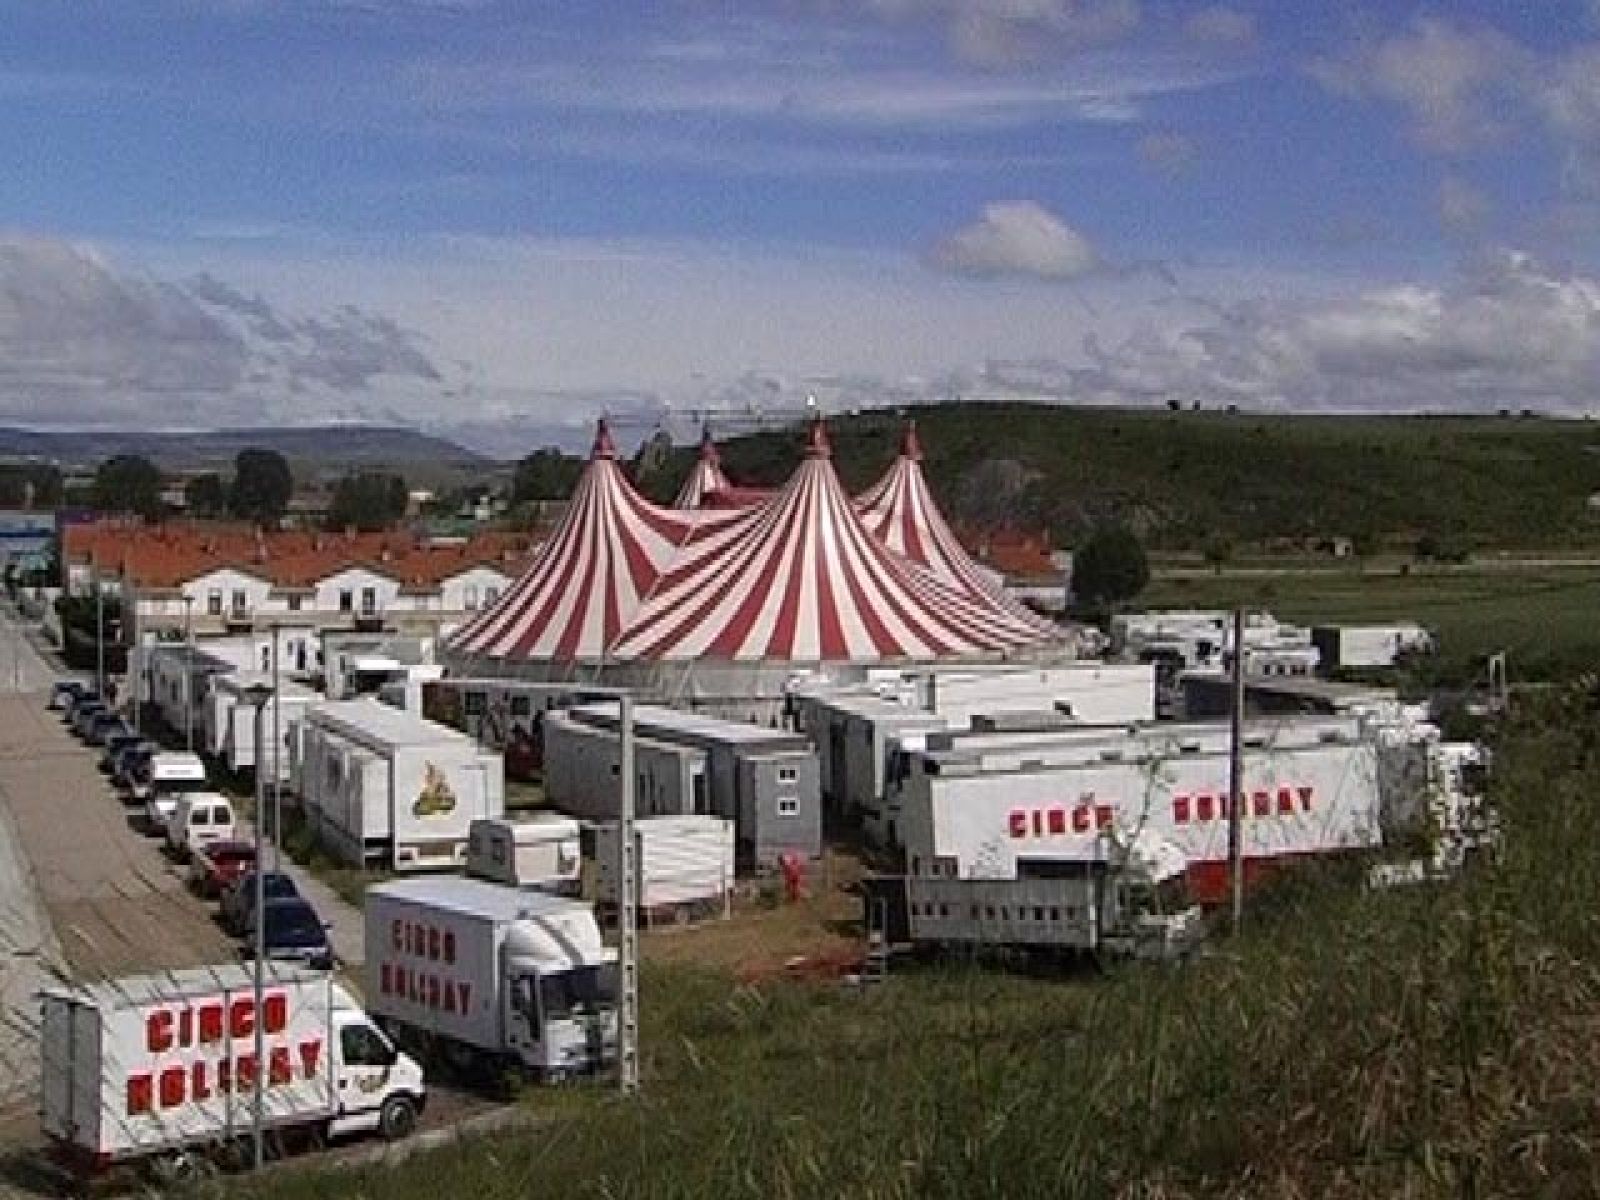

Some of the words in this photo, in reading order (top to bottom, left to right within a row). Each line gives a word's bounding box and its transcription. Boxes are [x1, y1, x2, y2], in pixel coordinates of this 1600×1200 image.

[393, 919, 456, 965] CIRCO
[381, 962, 471, 1017] HOLIDAY
[147, 995, 287, 1052] CIRCO
[127, 1040, 321, 1116] HOLIDAY
